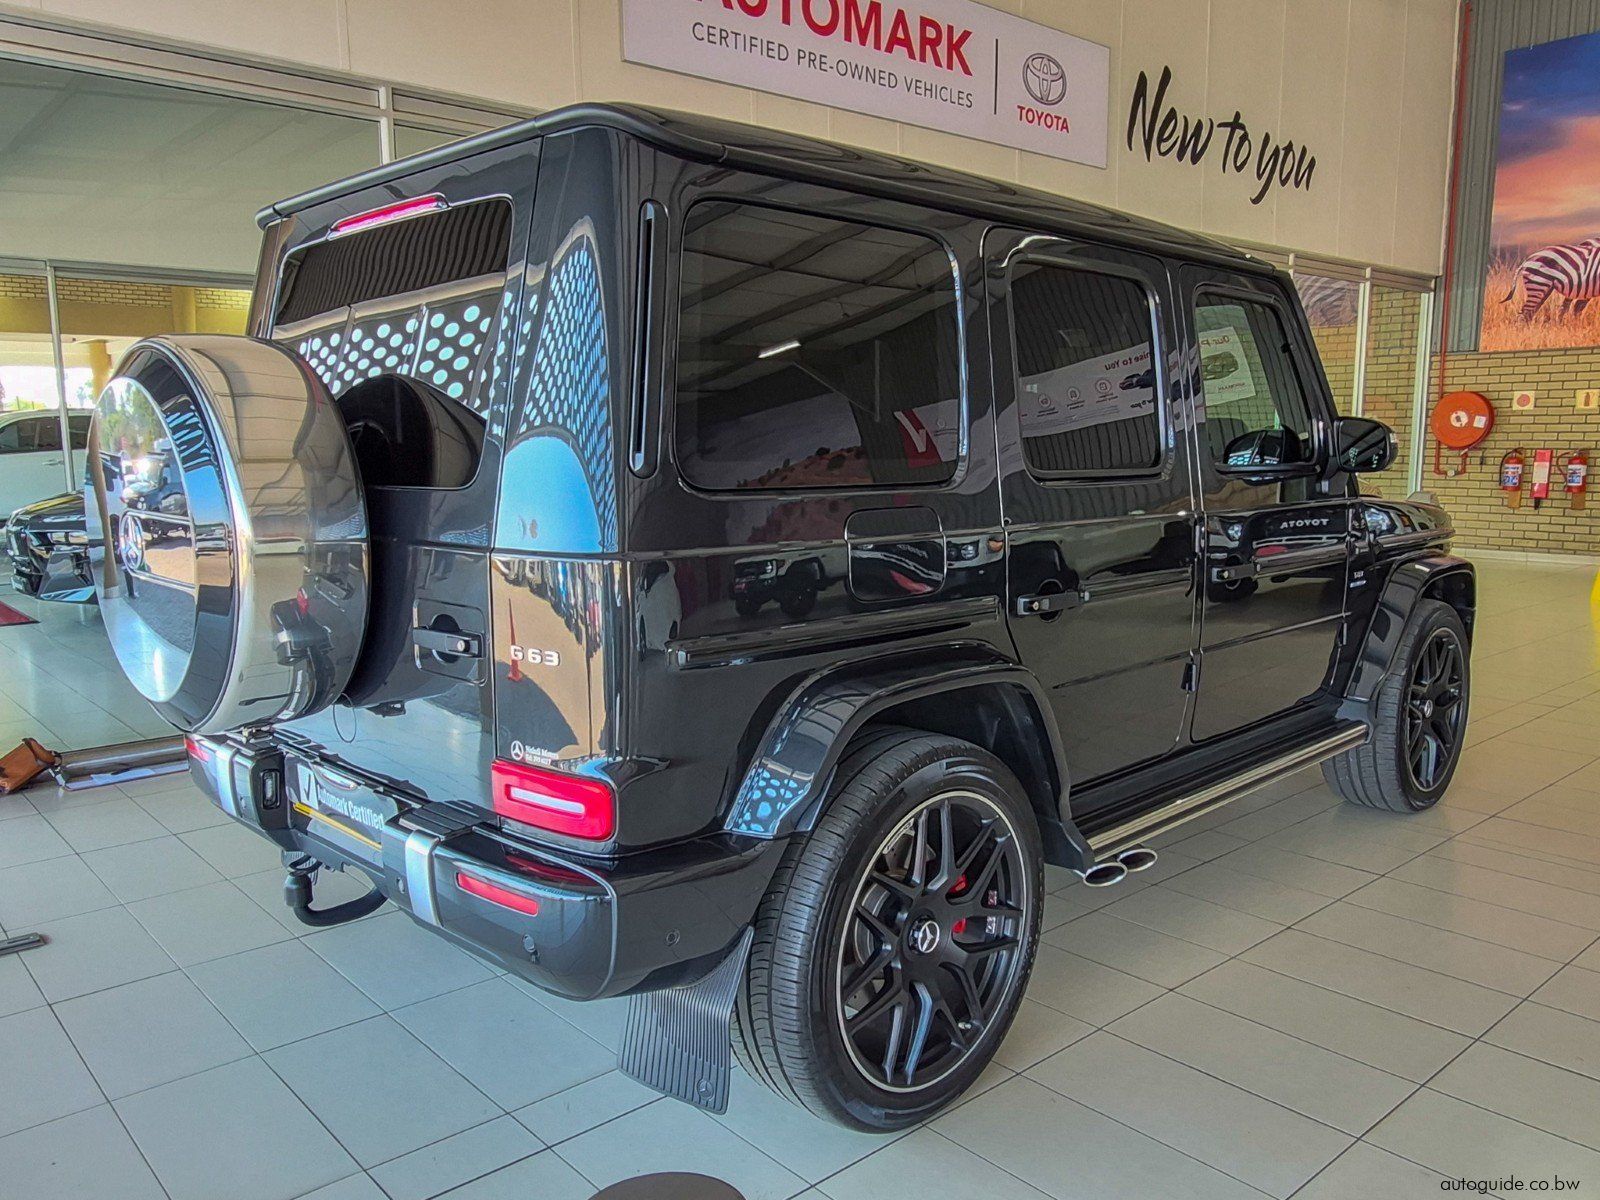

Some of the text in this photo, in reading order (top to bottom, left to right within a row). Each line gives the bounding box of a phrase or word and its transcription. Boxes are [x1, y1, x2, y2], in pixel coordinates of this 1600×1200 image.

[696, 0, 973, 76] OMARK
[692, 22, 973, 109] CERTIFIED PRE-OWNED VEHICLES
[1017, 105, 1070, 133] TOYOTA
[1127, 65, 1316, 205] New to you
[510, 645, 560, 667] G 63
[348, 800, 384, 831] Certified
